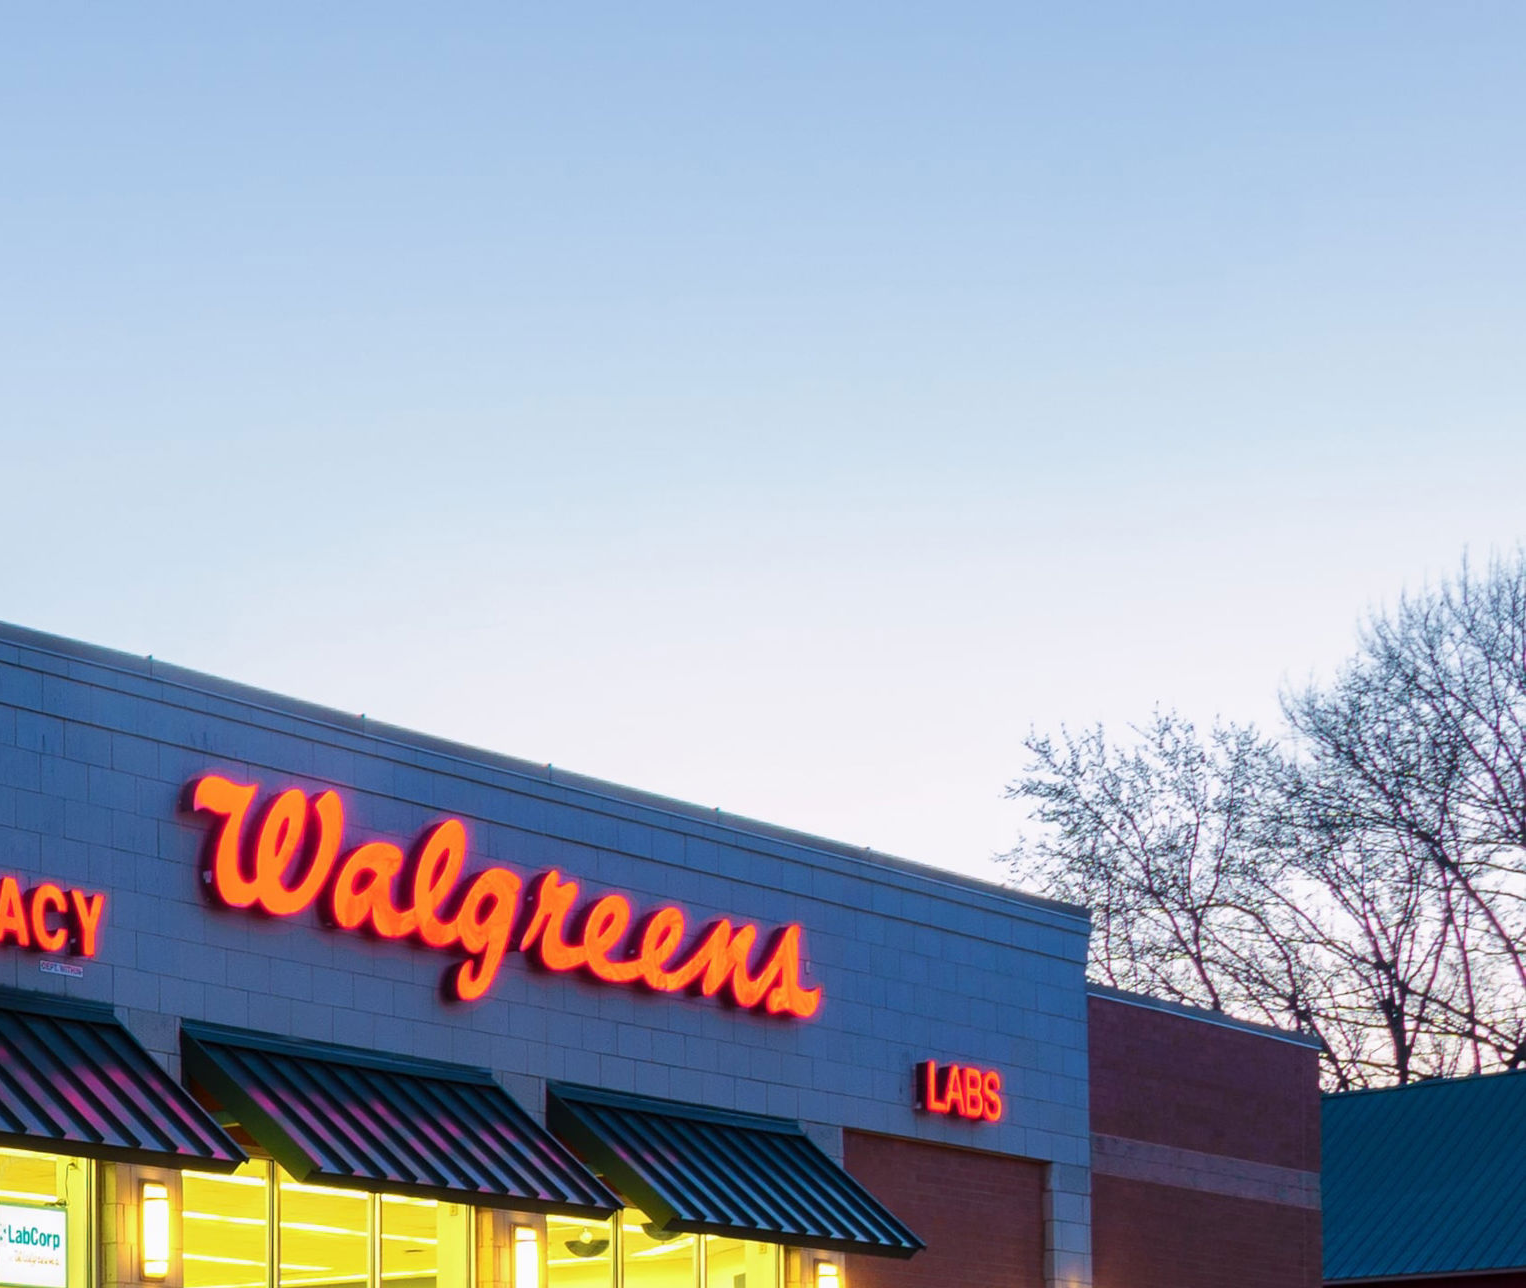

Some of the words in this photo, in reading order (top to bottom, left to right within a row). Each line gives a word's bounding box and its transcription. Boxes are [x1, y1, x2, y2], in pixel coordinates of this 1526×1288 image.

[193, 775, 823, 1018] Walgreens
[926, 1059, 1002, 1122] LABS
[7, 1223, 61, 1251] LabCorp
